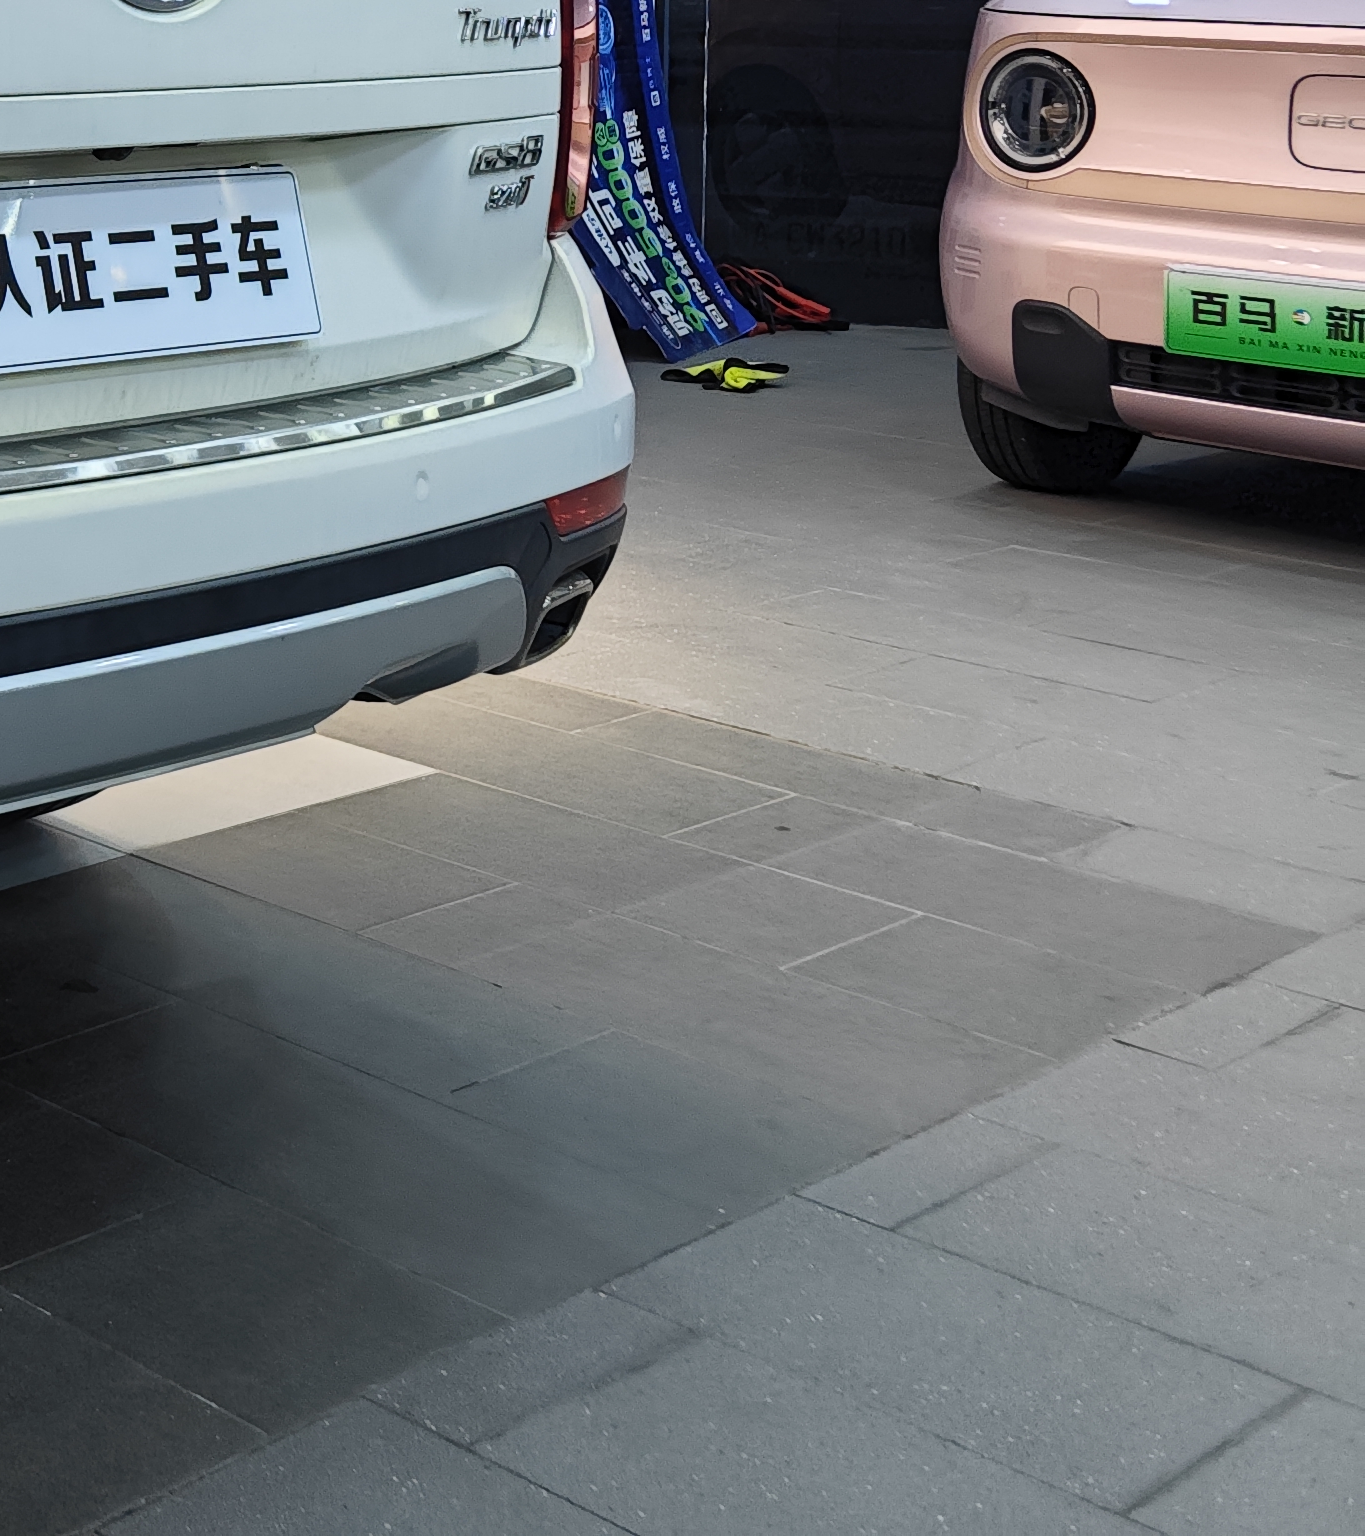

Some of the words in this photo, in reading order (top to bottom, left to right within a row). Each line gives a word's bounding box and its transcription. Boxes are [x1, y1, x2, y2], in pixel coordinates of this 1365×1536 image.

[469, 134, 544, 176] GS8
[1190, 290, 1276, 334] 百马
[1268, 340, 1289, 351] MA
[1296, 343, 1322, 354] XIN
